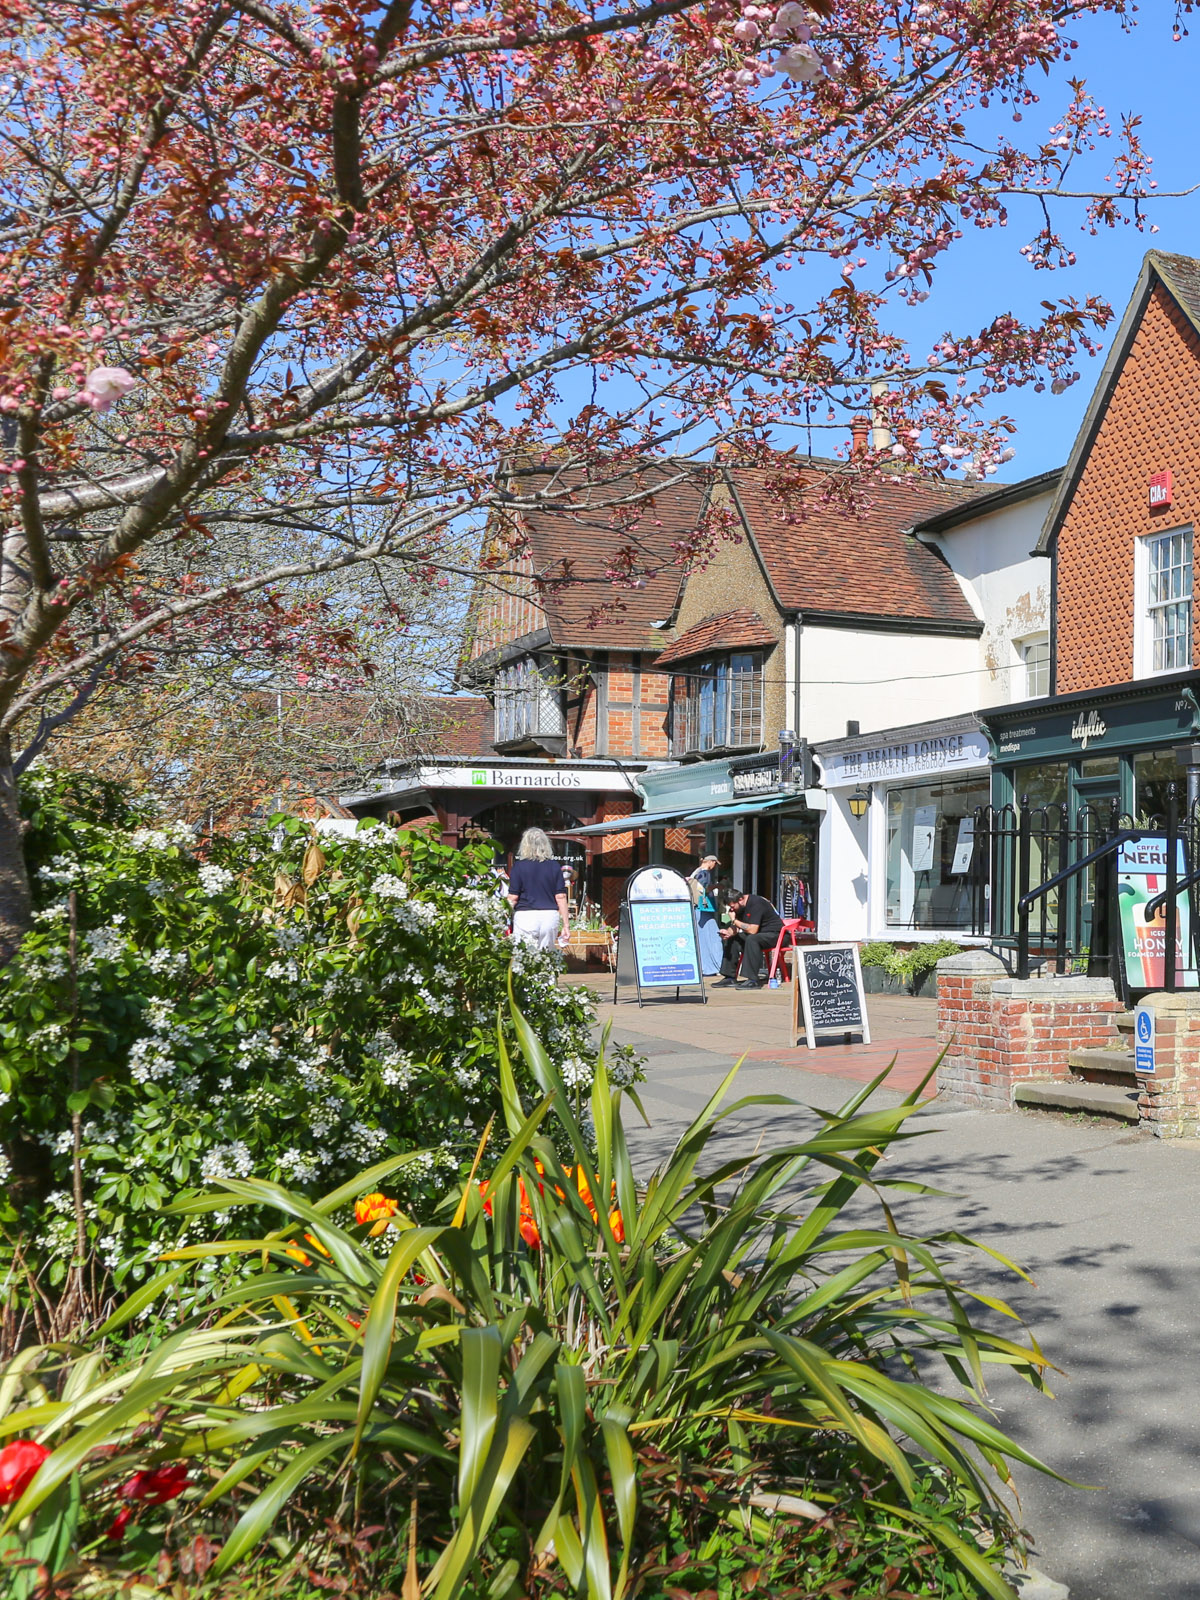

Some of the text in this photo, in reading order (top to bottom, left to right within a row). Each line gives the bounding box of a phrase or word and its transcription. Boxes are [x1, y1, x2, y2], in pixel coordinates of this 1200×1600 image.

[1000, 726, 1037, 742] spa treatments
[1071, 710, 1107, 749] idyllic
[843, 735, 963, 770] THE HEALTH LOUNGE
[1000, 742, 1020, 753] medispa
[492, 770, 581, 787] Barnardo's
[1133, 938, 1184, 950] HONY
